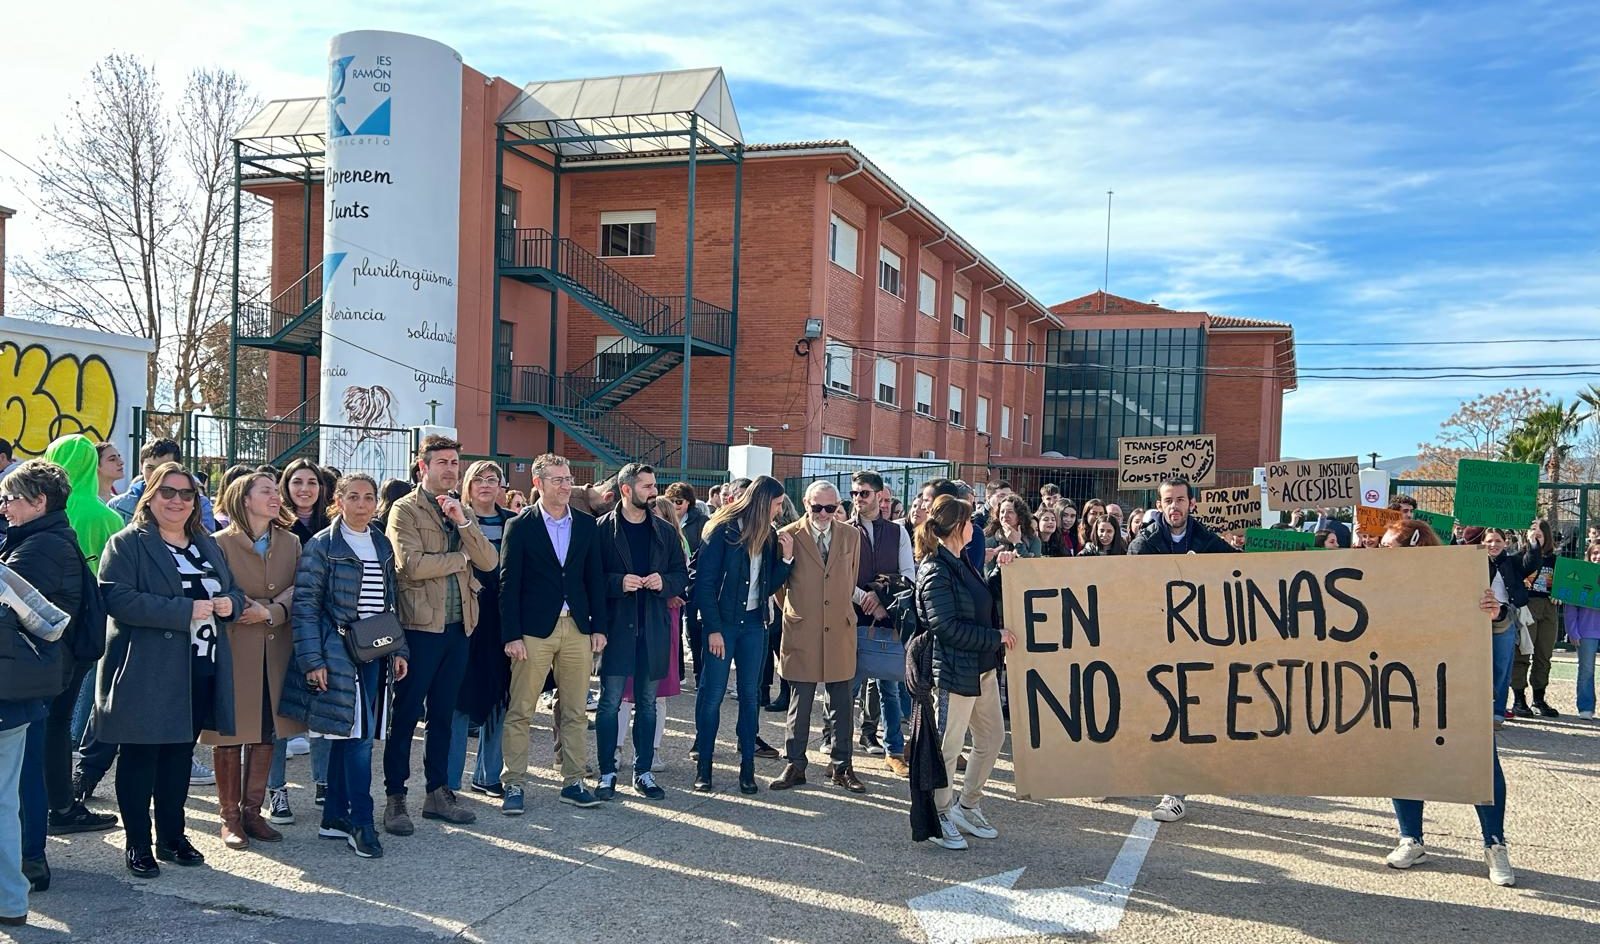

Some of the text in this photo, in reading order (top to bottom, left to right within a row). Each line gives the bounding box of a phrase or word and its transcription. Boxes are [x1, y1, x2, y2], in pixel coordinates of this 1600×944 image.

[376, 55, 392, 66] IES
[352, 66, 391, 79] RAMÓN
[373, 82, 391, 93] CID
[328, 199, 369, 222] Junts
[352, 257, 453, 290] plurilingüisme
[1124, 438, 1214, 453] TRANSFORMEM
[1269, 462, 1360, 479] POR UN INSTITUTO
[1232, 488, 1249, 502] UN
[1282, 477, 1354, 503] ACCESIBLE
[1226, 501, 1261, 516] TITUTO
[1023, 584, 1101, 653] EN
[1025, 660, 1121, 749] NO
[1146, 661, 1218, 745] SE
